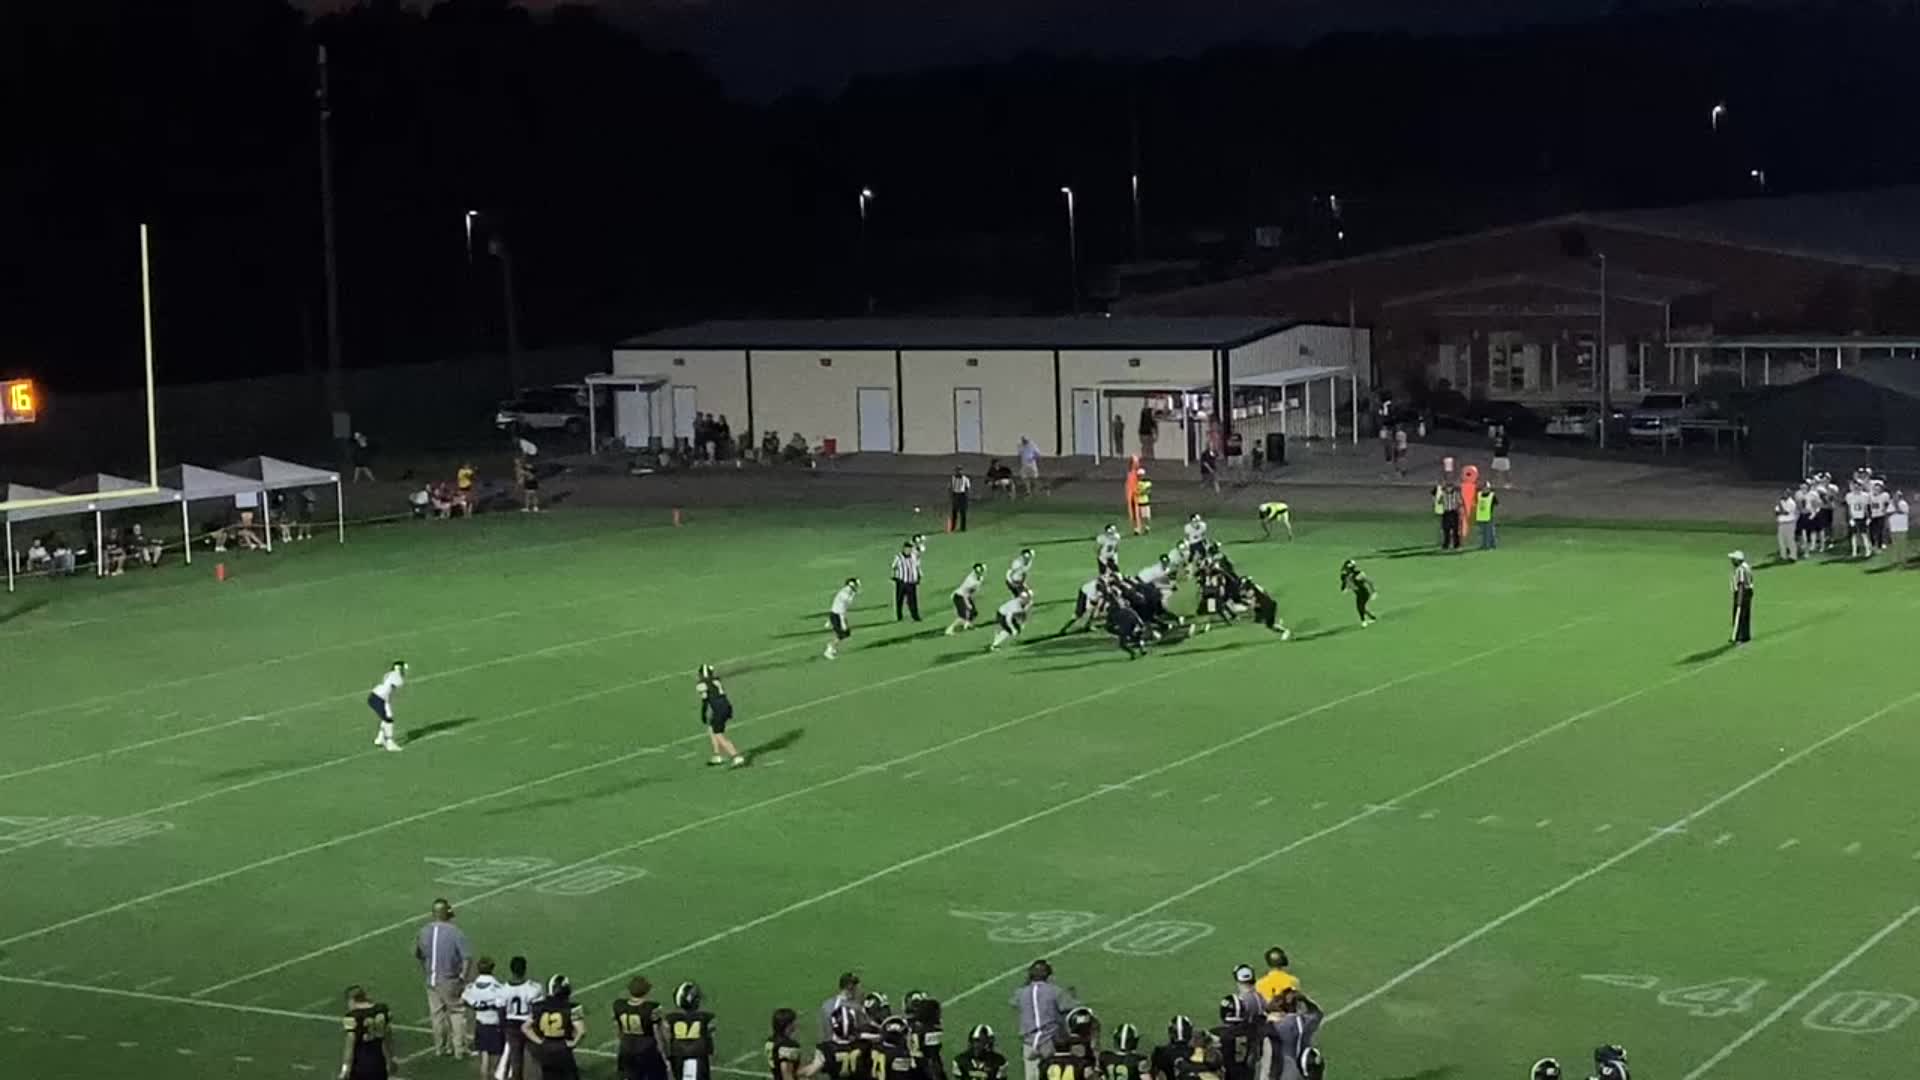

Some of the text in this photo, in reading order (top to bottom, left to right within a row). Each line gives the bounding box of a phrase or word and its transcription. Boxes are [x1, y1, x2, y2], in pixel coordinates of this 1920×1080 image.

[11, 383, 32, 410] 16
[987, 909, 1217, 956] 30
[1657, 976, 1919, 1034] 40
[539, 1011, 564, 1037] 42
